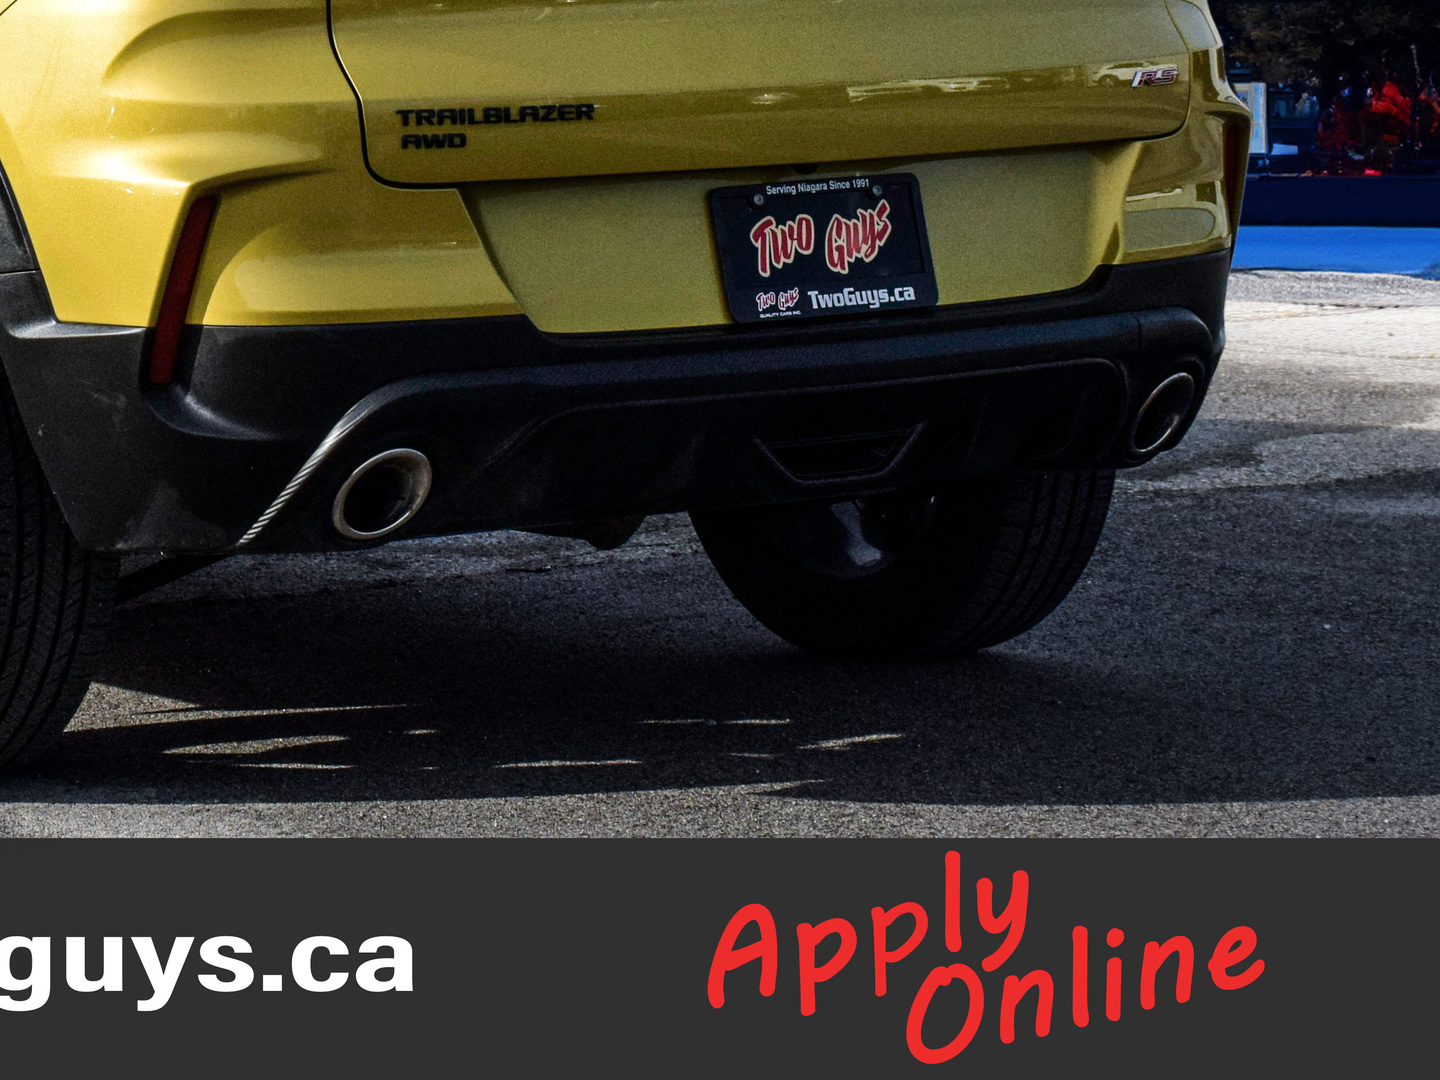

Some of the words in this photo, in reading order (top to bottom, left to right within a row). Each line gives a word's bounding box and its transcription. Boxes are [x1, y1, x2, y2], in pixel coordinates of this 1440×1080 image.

[1131, 67, 1178, 88] RS
[395, 104, 596, 127] TRAILBLAZER
[401, 133, 467, 150] AWD
[766, 185, 797, 195] Serving
[798, 183, 828, 193] Niagara
[829, 180, 851, 190] Since
[852, 178, 870, 188] 1991
[807, 286, 916, 309] TwoGuys.ca
